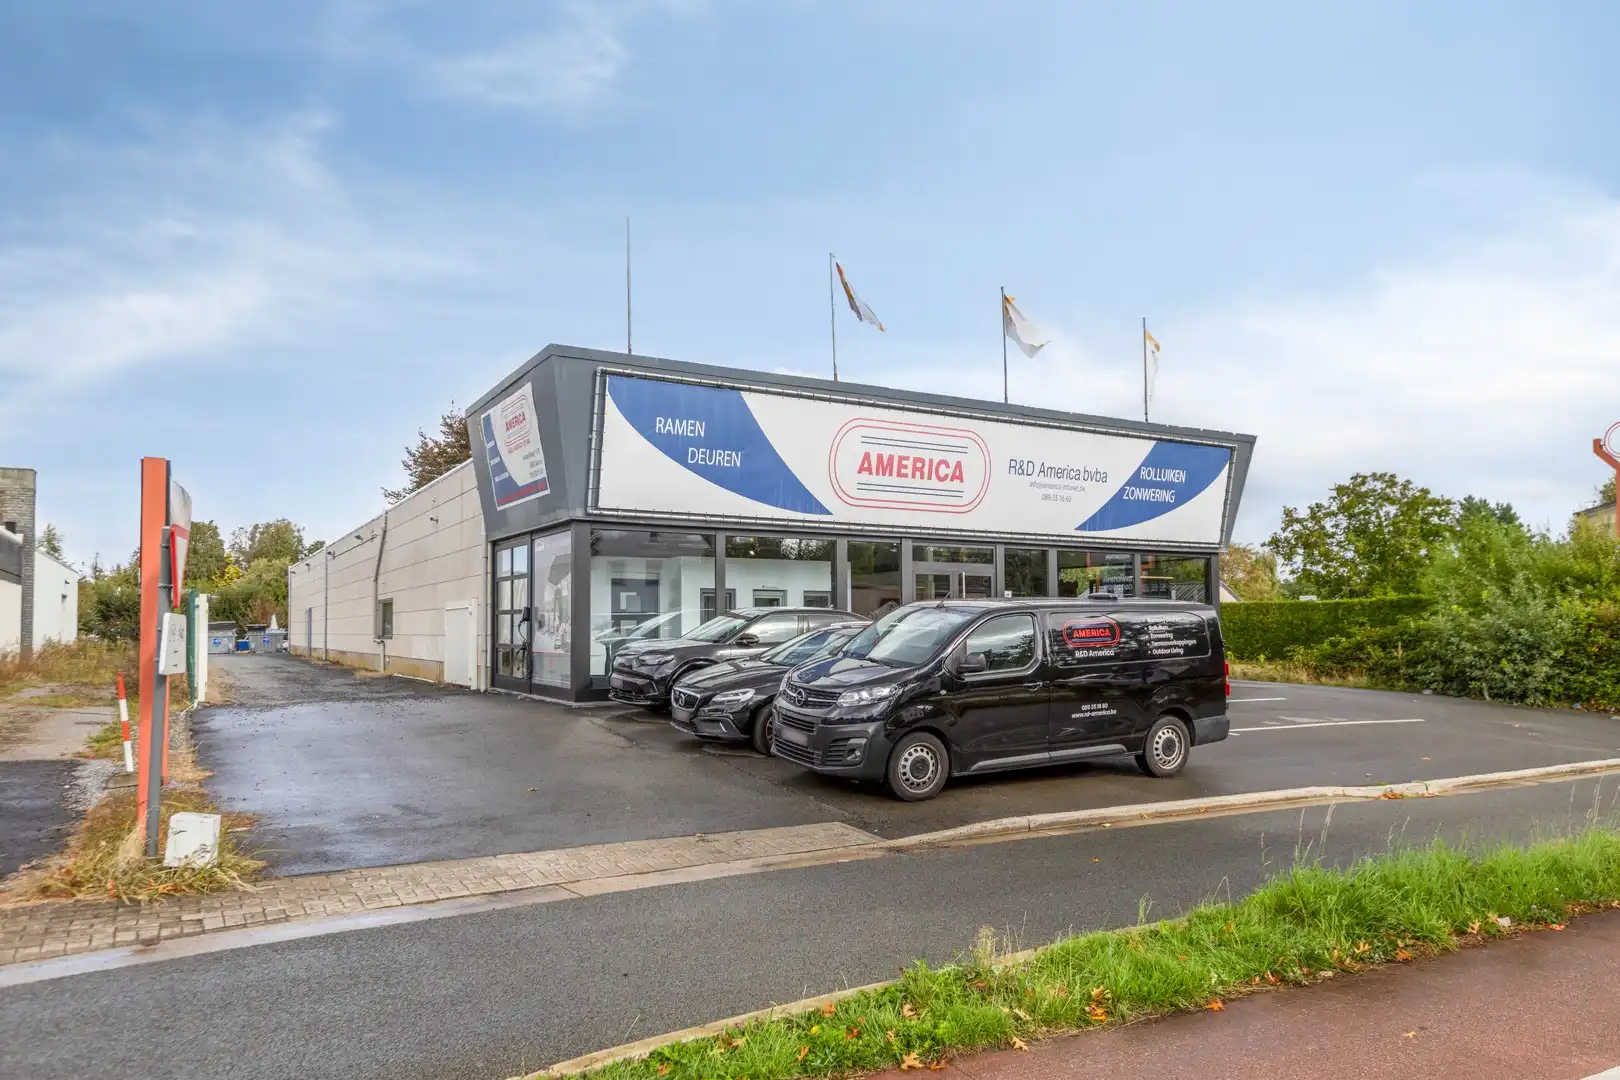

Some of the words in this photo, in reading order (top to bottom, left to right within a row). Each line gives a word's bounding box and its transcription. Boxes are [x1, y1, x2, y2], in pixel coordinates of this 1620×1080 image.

[656, 416, 705, 437] RAMEN
[687, 447, 742, 468] DEUREN
[857, 451, 965, 484] AMERICA
[1008, 458, 1035, 476] R&D
[1037, 461, 1081, 481] America
[1083, 466, 1108, 484] bvba
[1140, 466, 1187, 484] ROLLUIKEN
[1122, 486, 1176, 503] ZONWERING
[1073, 628, 1111, 638] AMERICA
[1089, 649, 1115, 657] America
